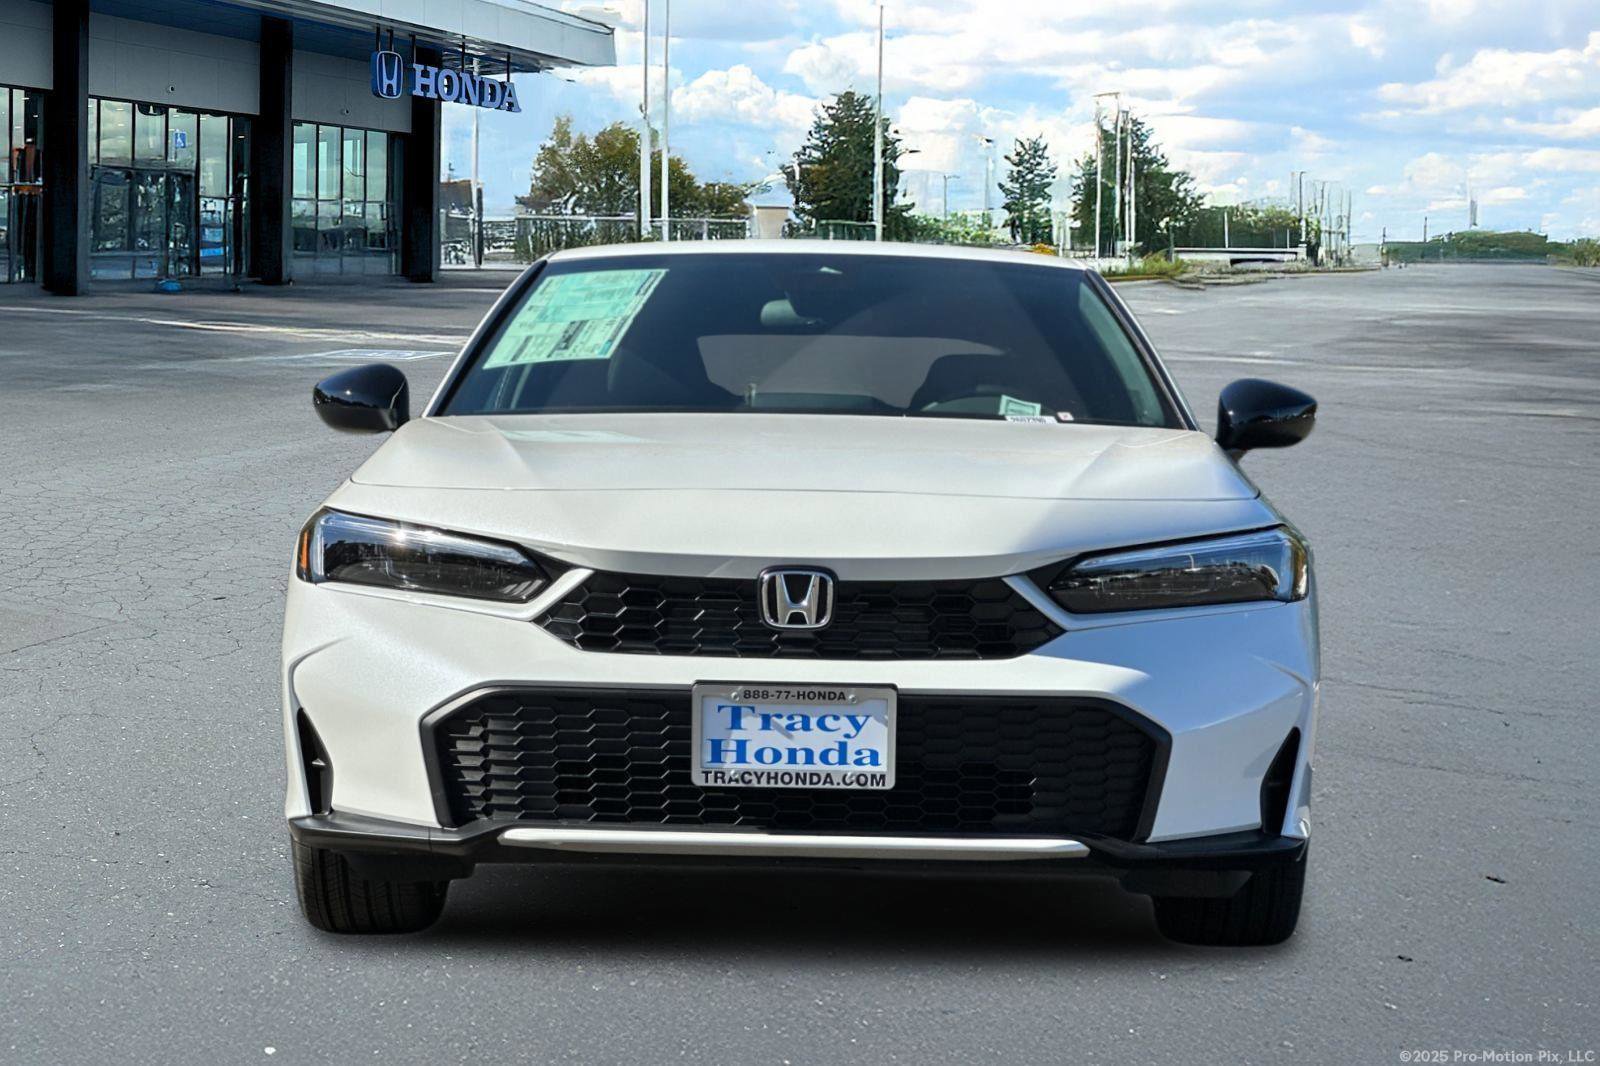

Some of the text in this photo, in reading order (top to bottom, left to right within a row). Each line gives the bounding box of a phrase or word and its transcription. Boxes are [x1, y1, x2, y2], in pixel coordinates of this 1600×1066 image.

[412, 63, 522, 113] HONDA
[743, 690, 846, 701] 888-77-HONDA
[717, 704, 871, 739] Tracy
[706, 738, 882, 767] Honda
[701, 771, 887, 787] TRACYHONDA.COM
